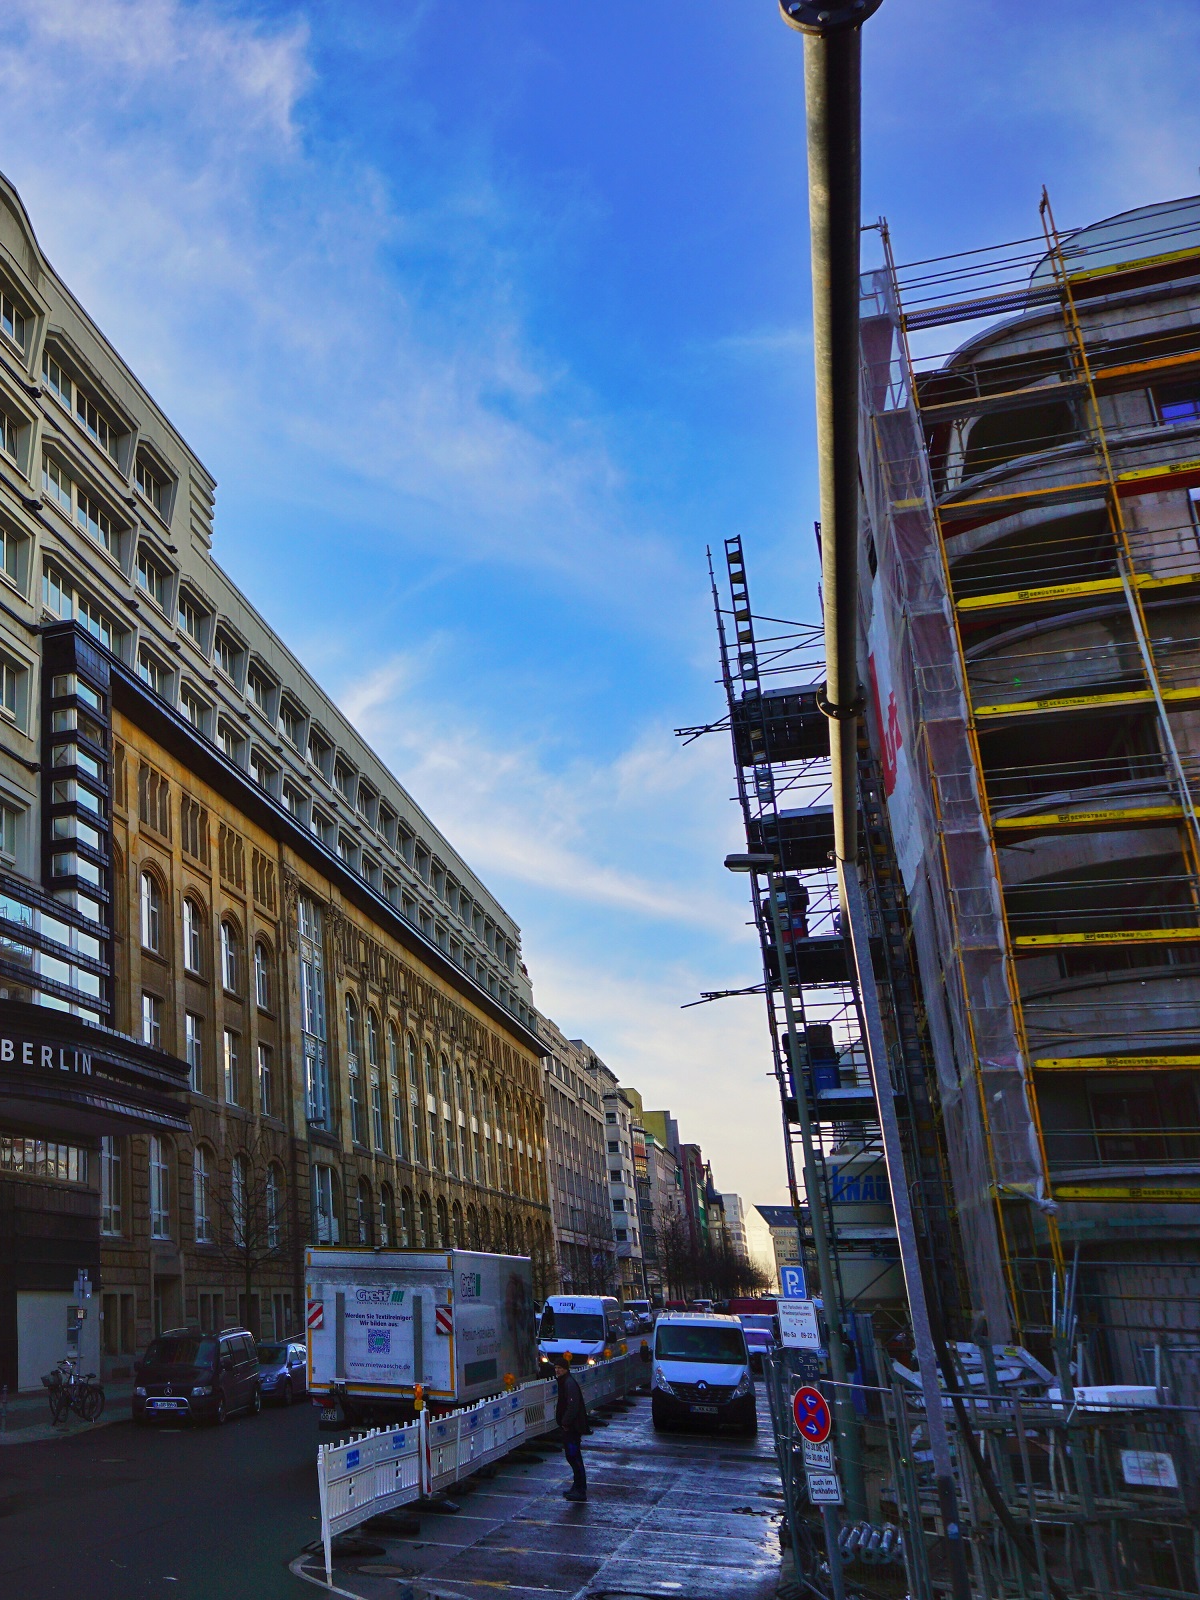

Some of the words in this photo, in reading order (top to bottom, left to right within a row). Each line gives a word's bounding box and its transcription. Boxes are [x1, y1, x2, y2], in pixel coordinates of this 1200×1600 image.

[832, 1165, 888, 1202] KNAU
[785, 1270, 799, 1295] P
[356, 1289, 391, 1302] Greif
